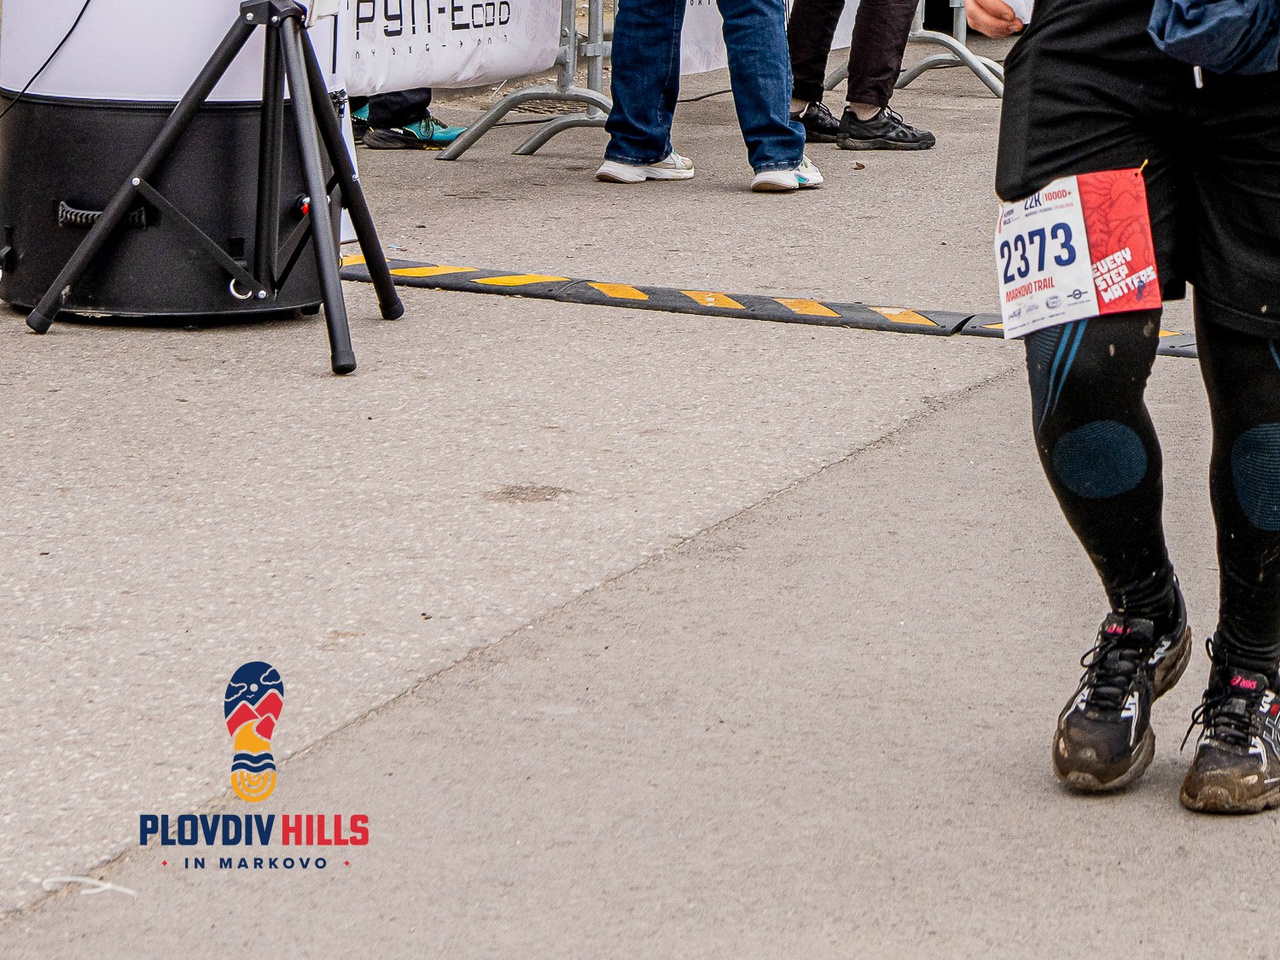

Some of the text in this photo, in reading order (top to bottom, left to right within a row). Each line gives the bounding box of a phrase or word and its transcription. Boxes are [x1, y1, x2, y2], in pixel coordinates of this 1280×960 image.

[1000, 222, 1076, 284] 2373
[1091, 247, 1132, 279] EVERY
[1006, 282, 1033, 303] MARKOVO
[1033, 276, 1055, 292] TRAIL
[1094, 264, 1129, 291] STEP
[1100, 265, 1157, 303] MATTERS
